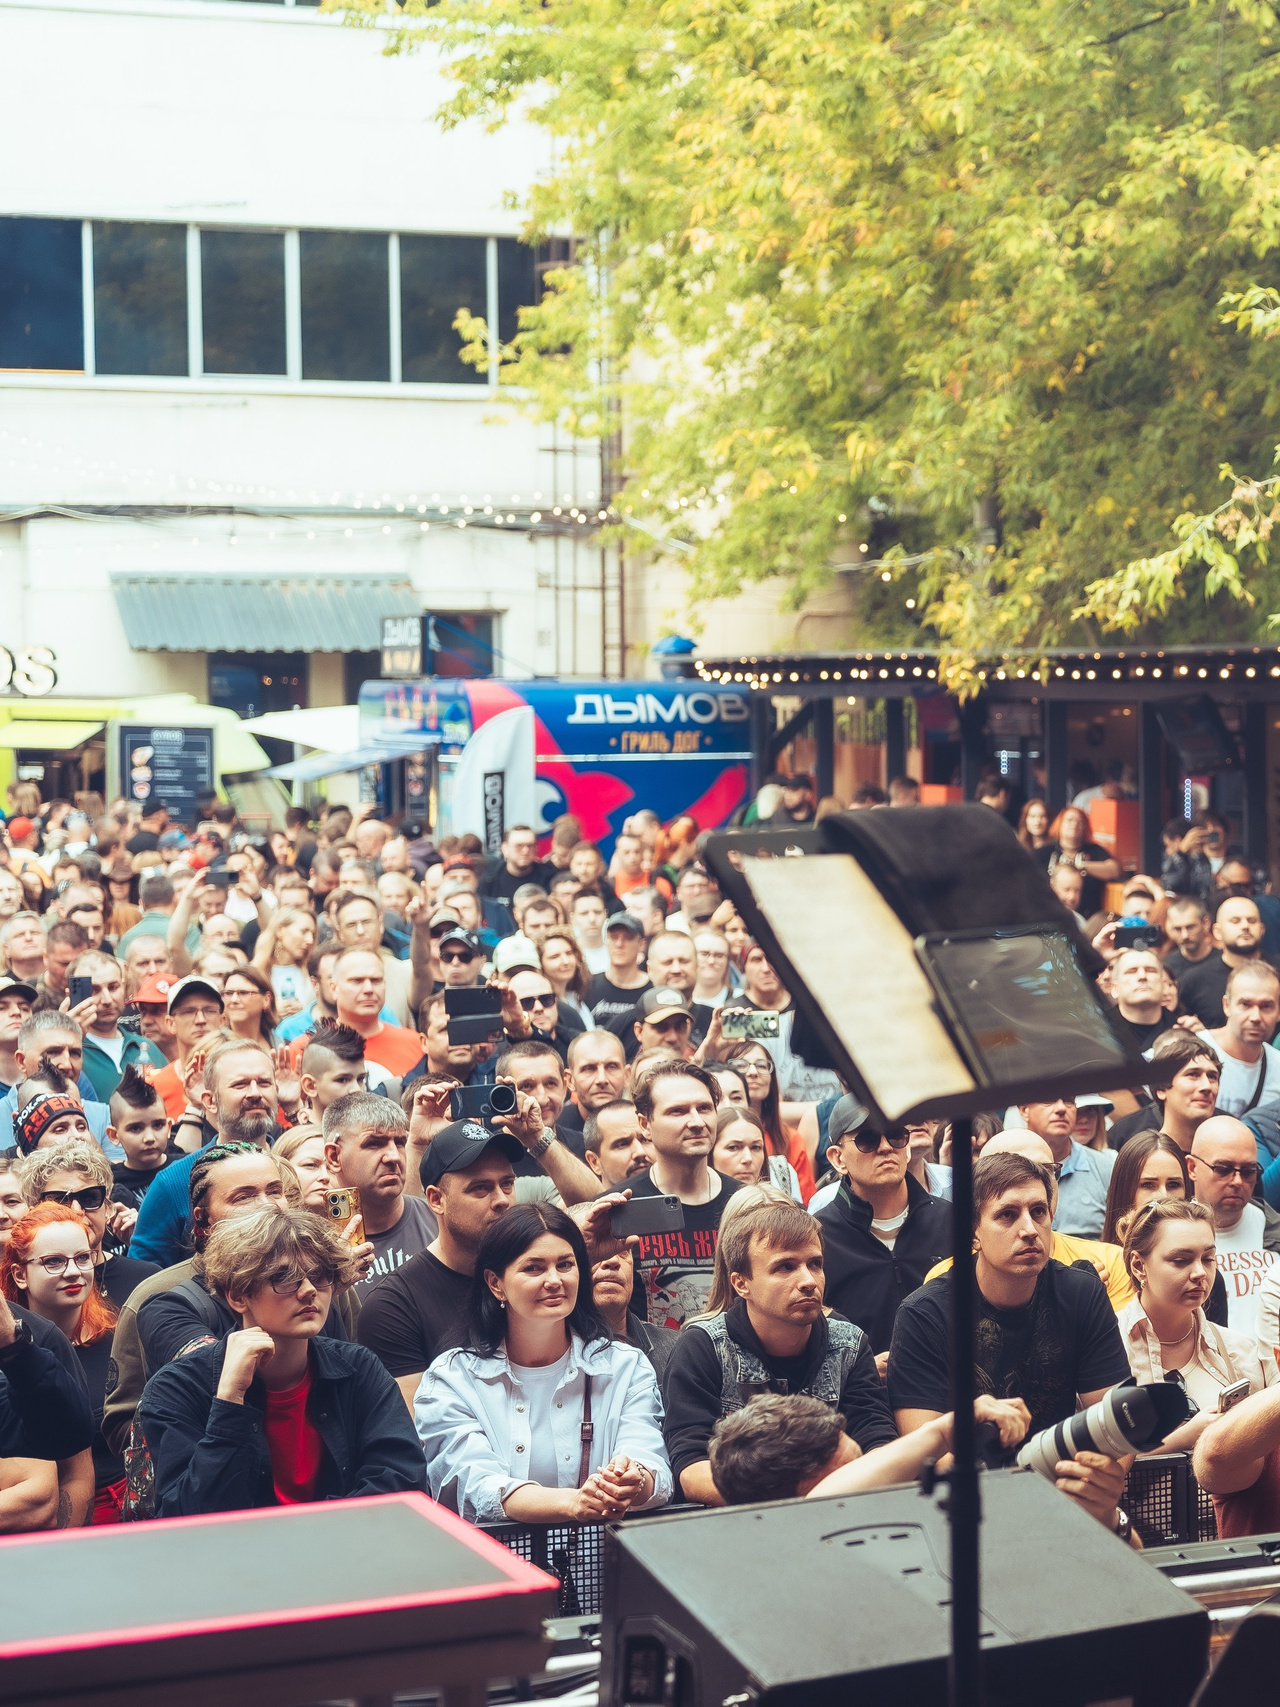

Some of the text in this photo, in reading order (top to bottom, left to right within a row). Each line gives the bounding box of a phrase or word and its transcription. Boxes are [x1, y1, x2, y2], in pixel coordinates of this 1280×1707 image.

[566, 693, 749, 724] ДЫМОВ
[621, 731, 702, 753] ГРИЛЬ ДОГ
[485, 774, 502, 858] ЫМОВ
[639, 1231, 691, 1260] РУСЬ
[1233, 1269, 1268, 1298] DA
[1121, 1401, 1136, 1429] Canon
